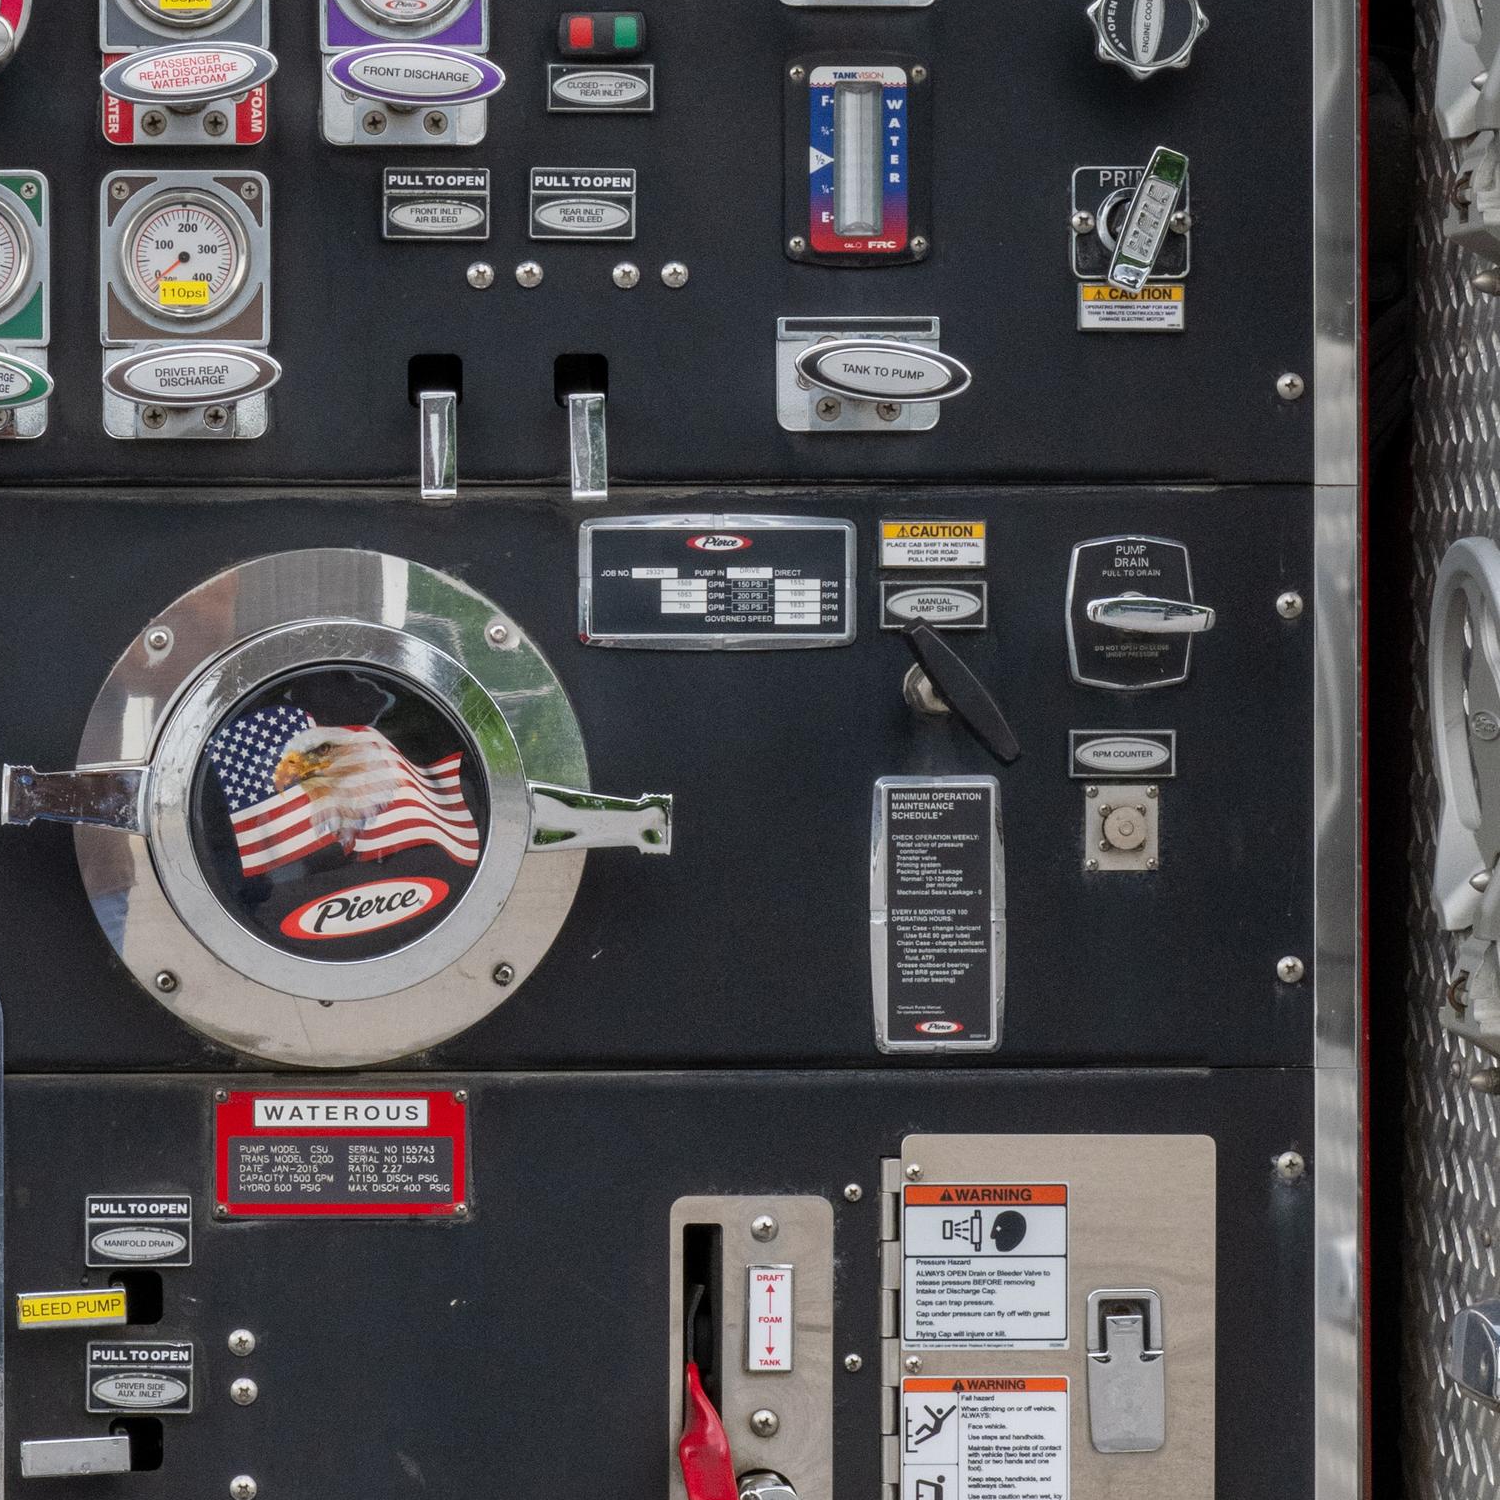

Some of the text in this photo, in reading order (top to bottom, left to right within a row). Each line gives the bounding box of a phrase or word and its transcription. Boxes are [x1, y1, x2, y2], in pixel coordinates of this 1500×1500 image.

[1108, 0, 1118, 31] OPEN
[1141, 22, 1151, 53] ENGINE
[154, 55, 221, 69] PASSENGER
[139, 63, 237, 81] REAR DISCHARGE
[363, 66, 470, 82] FRONT DISCHARGE
[151, 74, 227, 89] WATER-FOAM
[389, 176, 485, 186] PULL TO OPEN
[162, 287, 206, 300] 110psi
[155, 365, 229, 377] DRIVER REAR
[842, 364, 924, 380] TANK TO PUMP
[160, 375, 225, 386] DISCHARGE
[910, 526, 973, 537] CAUTION
[1116, 546, 1147, 555] PUMP
[1115, 558, 1148, 567] DRAIN
[892, 802, 954, 810] MAINTENANCE
[314, 885, 420, 933] Pierce
[264, 1106, 419, 1120] WATEROUS
[349, 1146, 379, 1154] SERIAL
[240, 1174, 283, 1182] CAPACITY
[956, 1189, 1031, 1200] WARNING
[22, 1299, 121, 1316] BLEED PUMP
[968, 1380, 1025, 1389] WARNING
